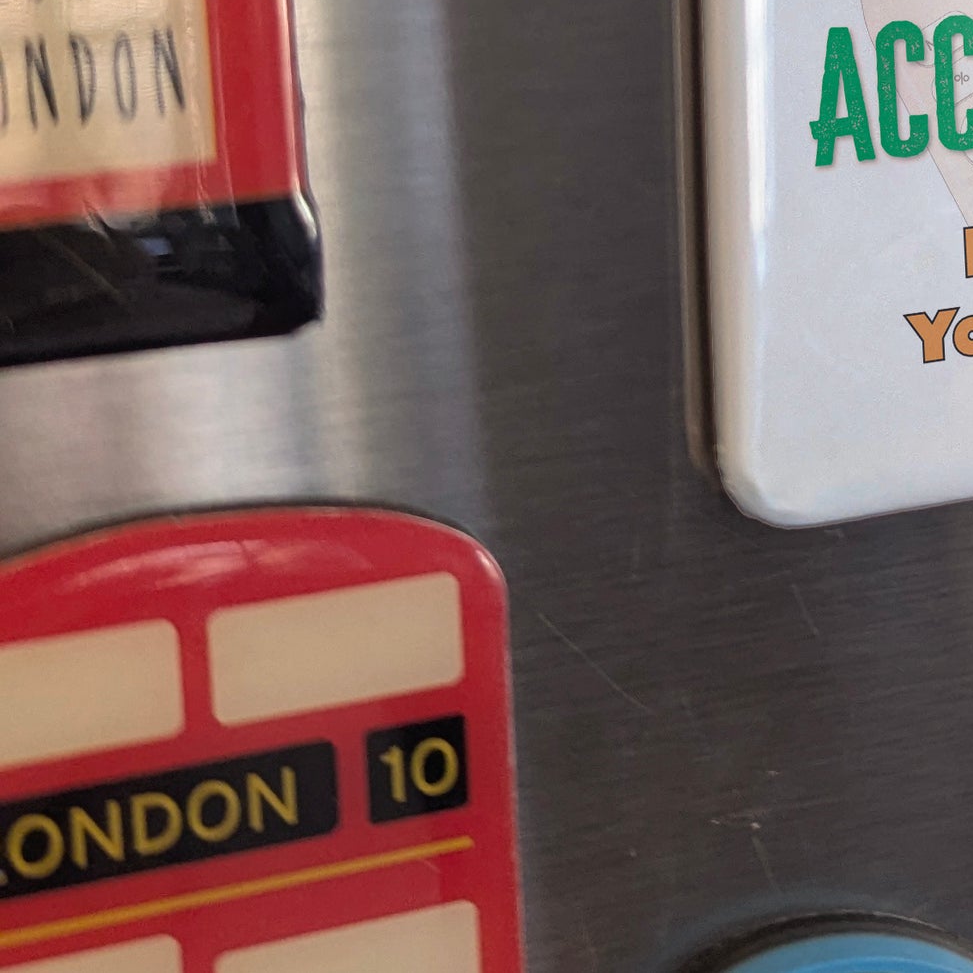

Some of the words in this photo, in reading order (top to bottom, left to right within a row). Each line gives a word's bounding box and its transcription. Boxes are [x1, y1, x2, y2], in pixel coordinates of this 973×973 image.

[0, 25, 187, 135] NDON
[0, 765, 299, 886] ONDON
[379, 736, 459, 804] 10
